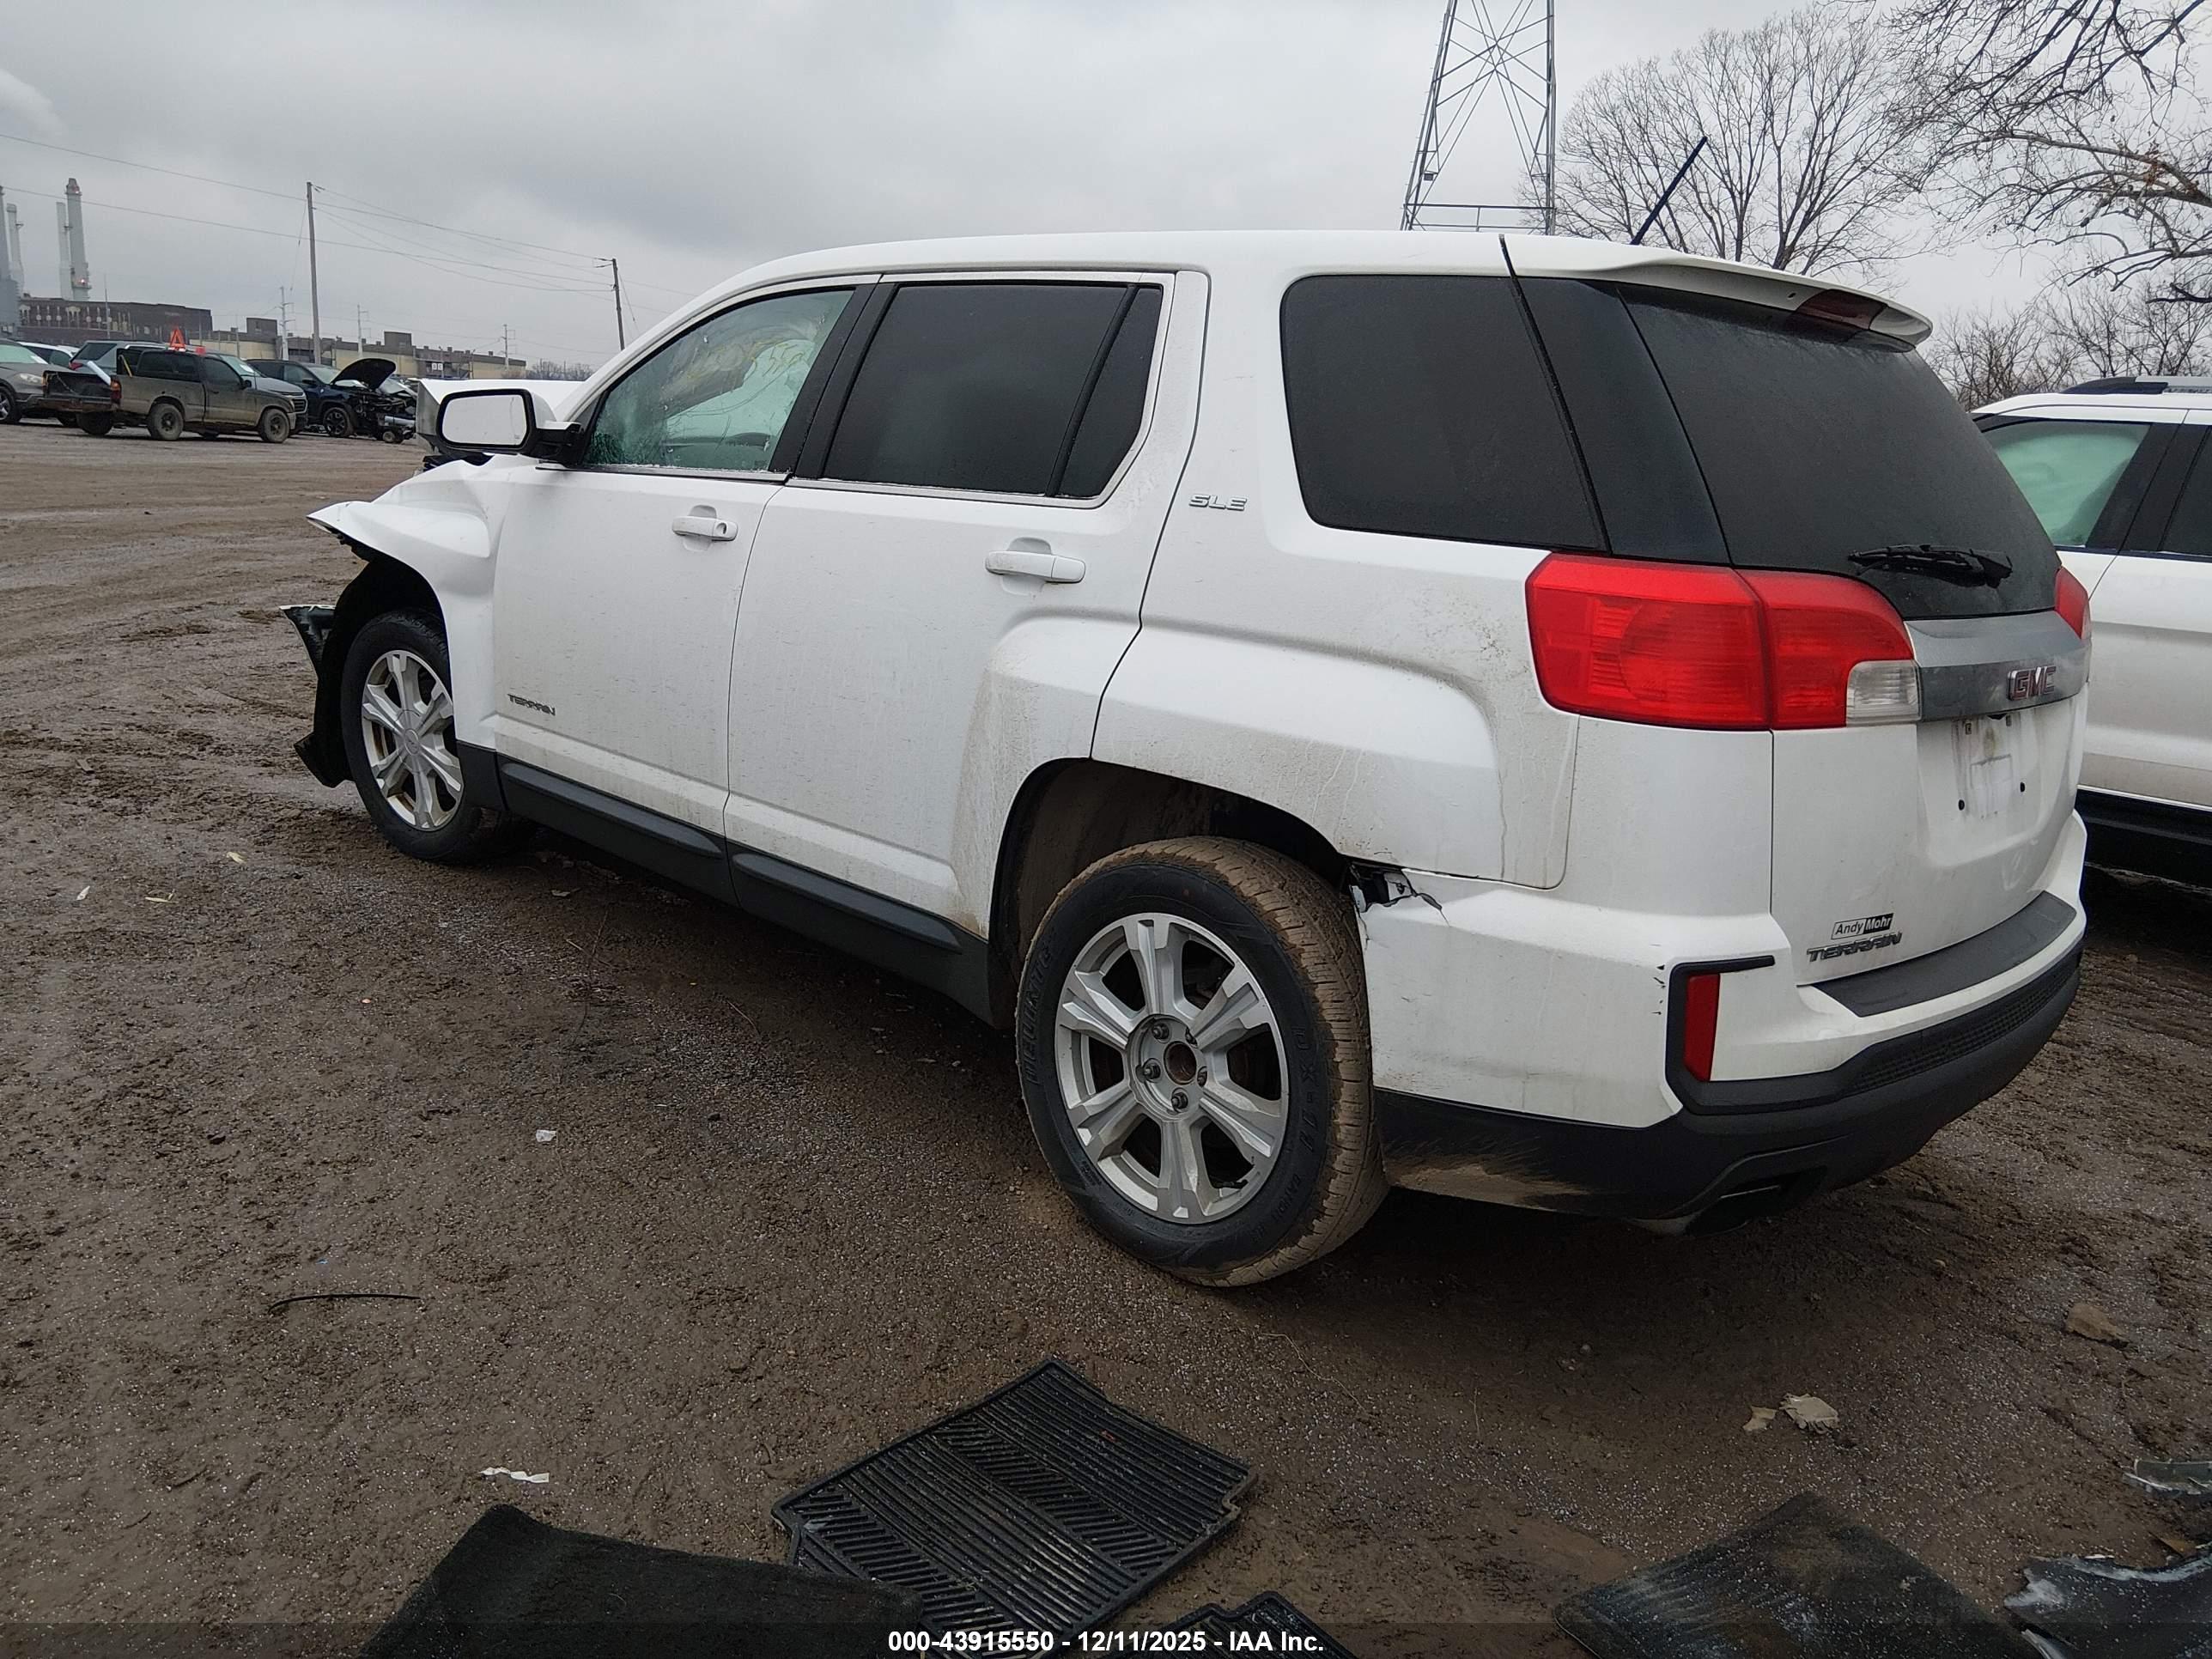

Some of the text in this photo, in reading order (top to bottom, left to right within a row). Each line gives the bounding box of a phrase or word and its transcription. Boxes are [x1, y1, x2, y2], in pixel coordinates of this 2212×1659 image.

[1188, 494, 1248, 512] SLE
[2007, 665, 2057, 701] GMC
[507, 693, 556, 716] TERRAIN
[1835, 916, 1893, 935] Andy Mohr
[1806, 931, 1903, 963] TERRAIN
